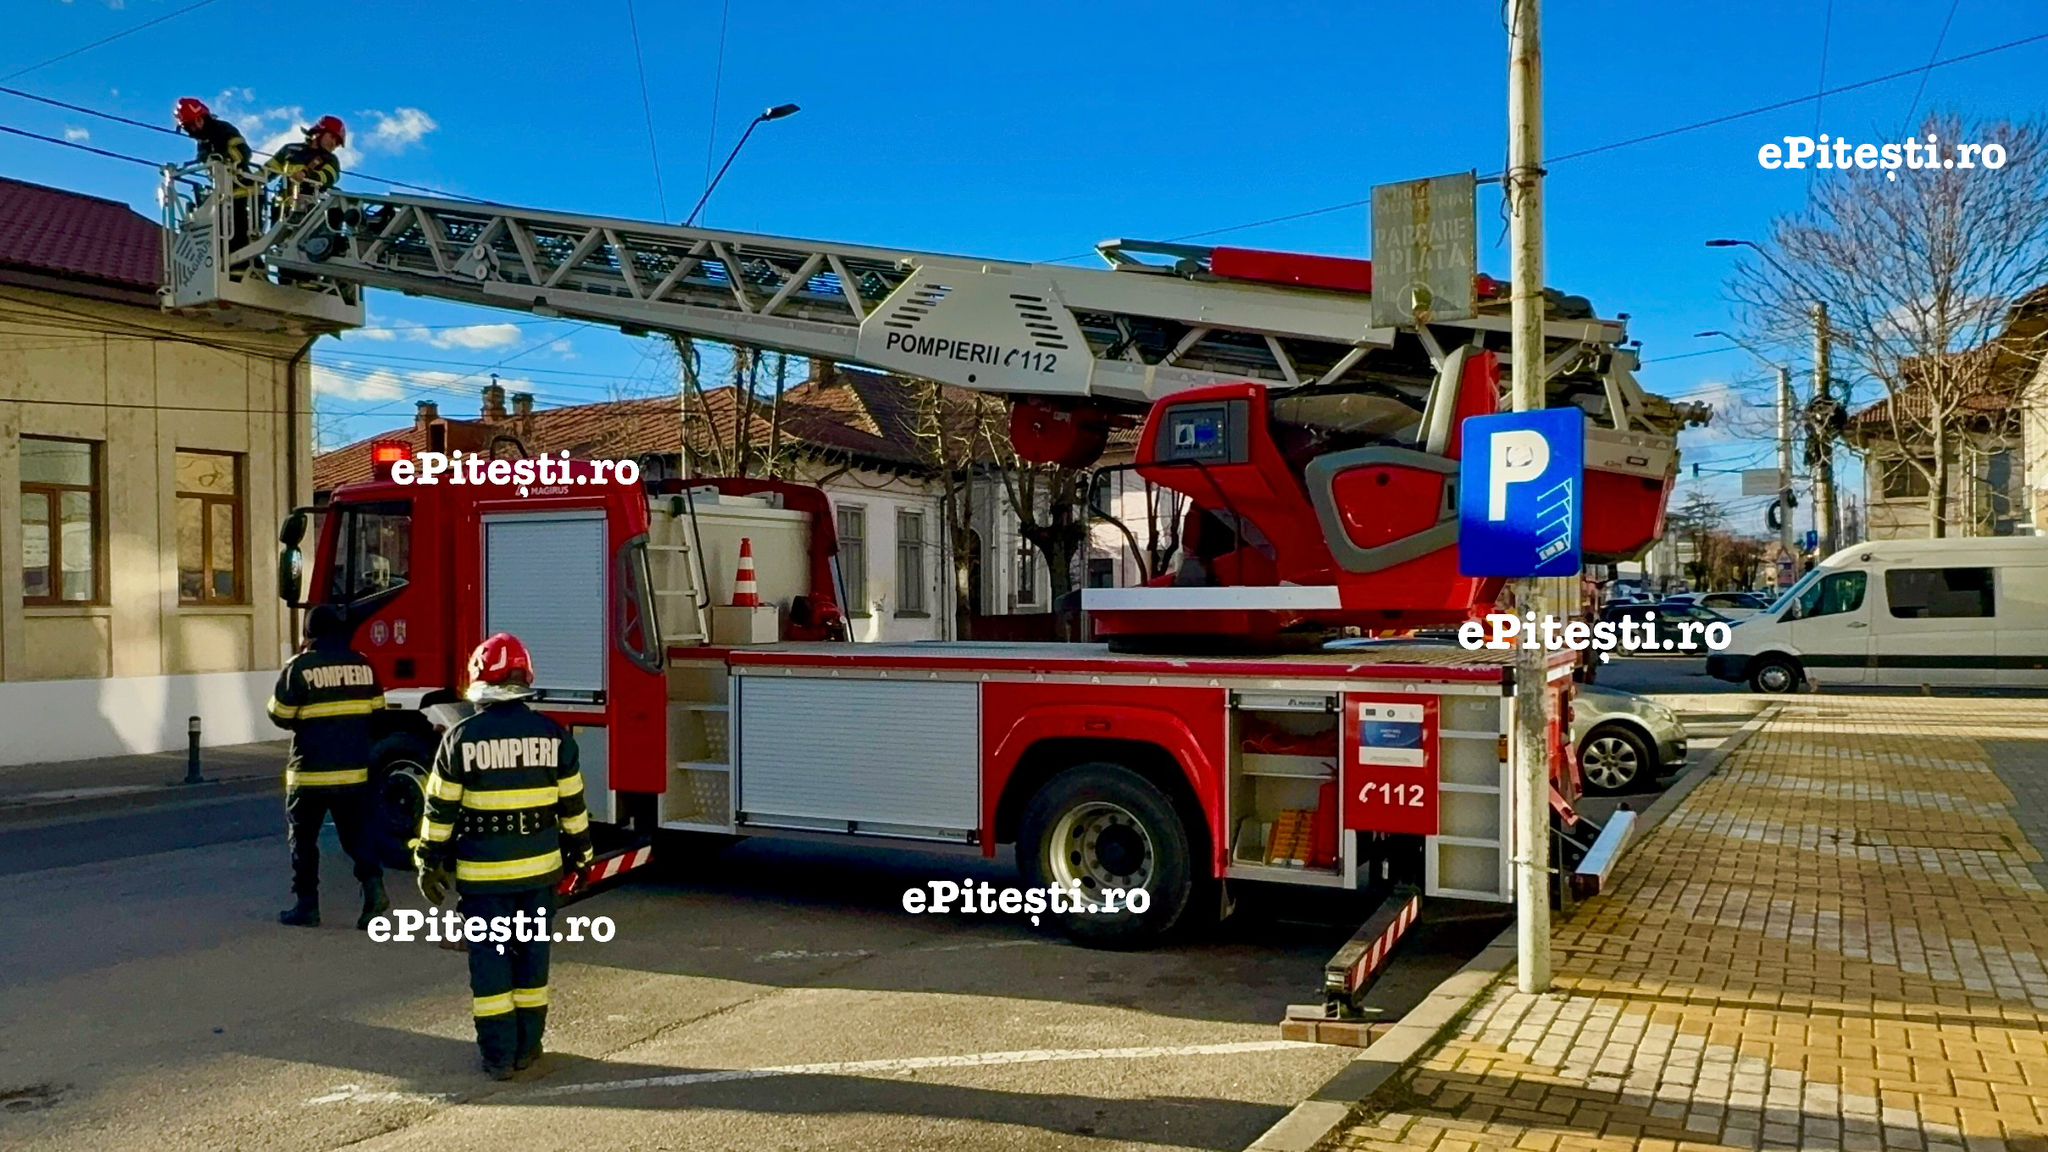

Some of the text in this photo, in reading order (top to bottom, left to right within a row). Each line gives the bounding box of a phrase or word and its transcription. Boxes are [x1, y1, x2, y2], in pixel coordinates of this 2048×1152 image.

[1377, 192, 1465, 216] MUNTNIA
[886, 332, 1057, 374] POMPIERII 112
[1488, 429, 1550, 521] P
[530, 485, 569, 496] MAGIRUS
[462, 737, 562, 772] POMPIERI
[1379, 783, 1425, 807] 112
